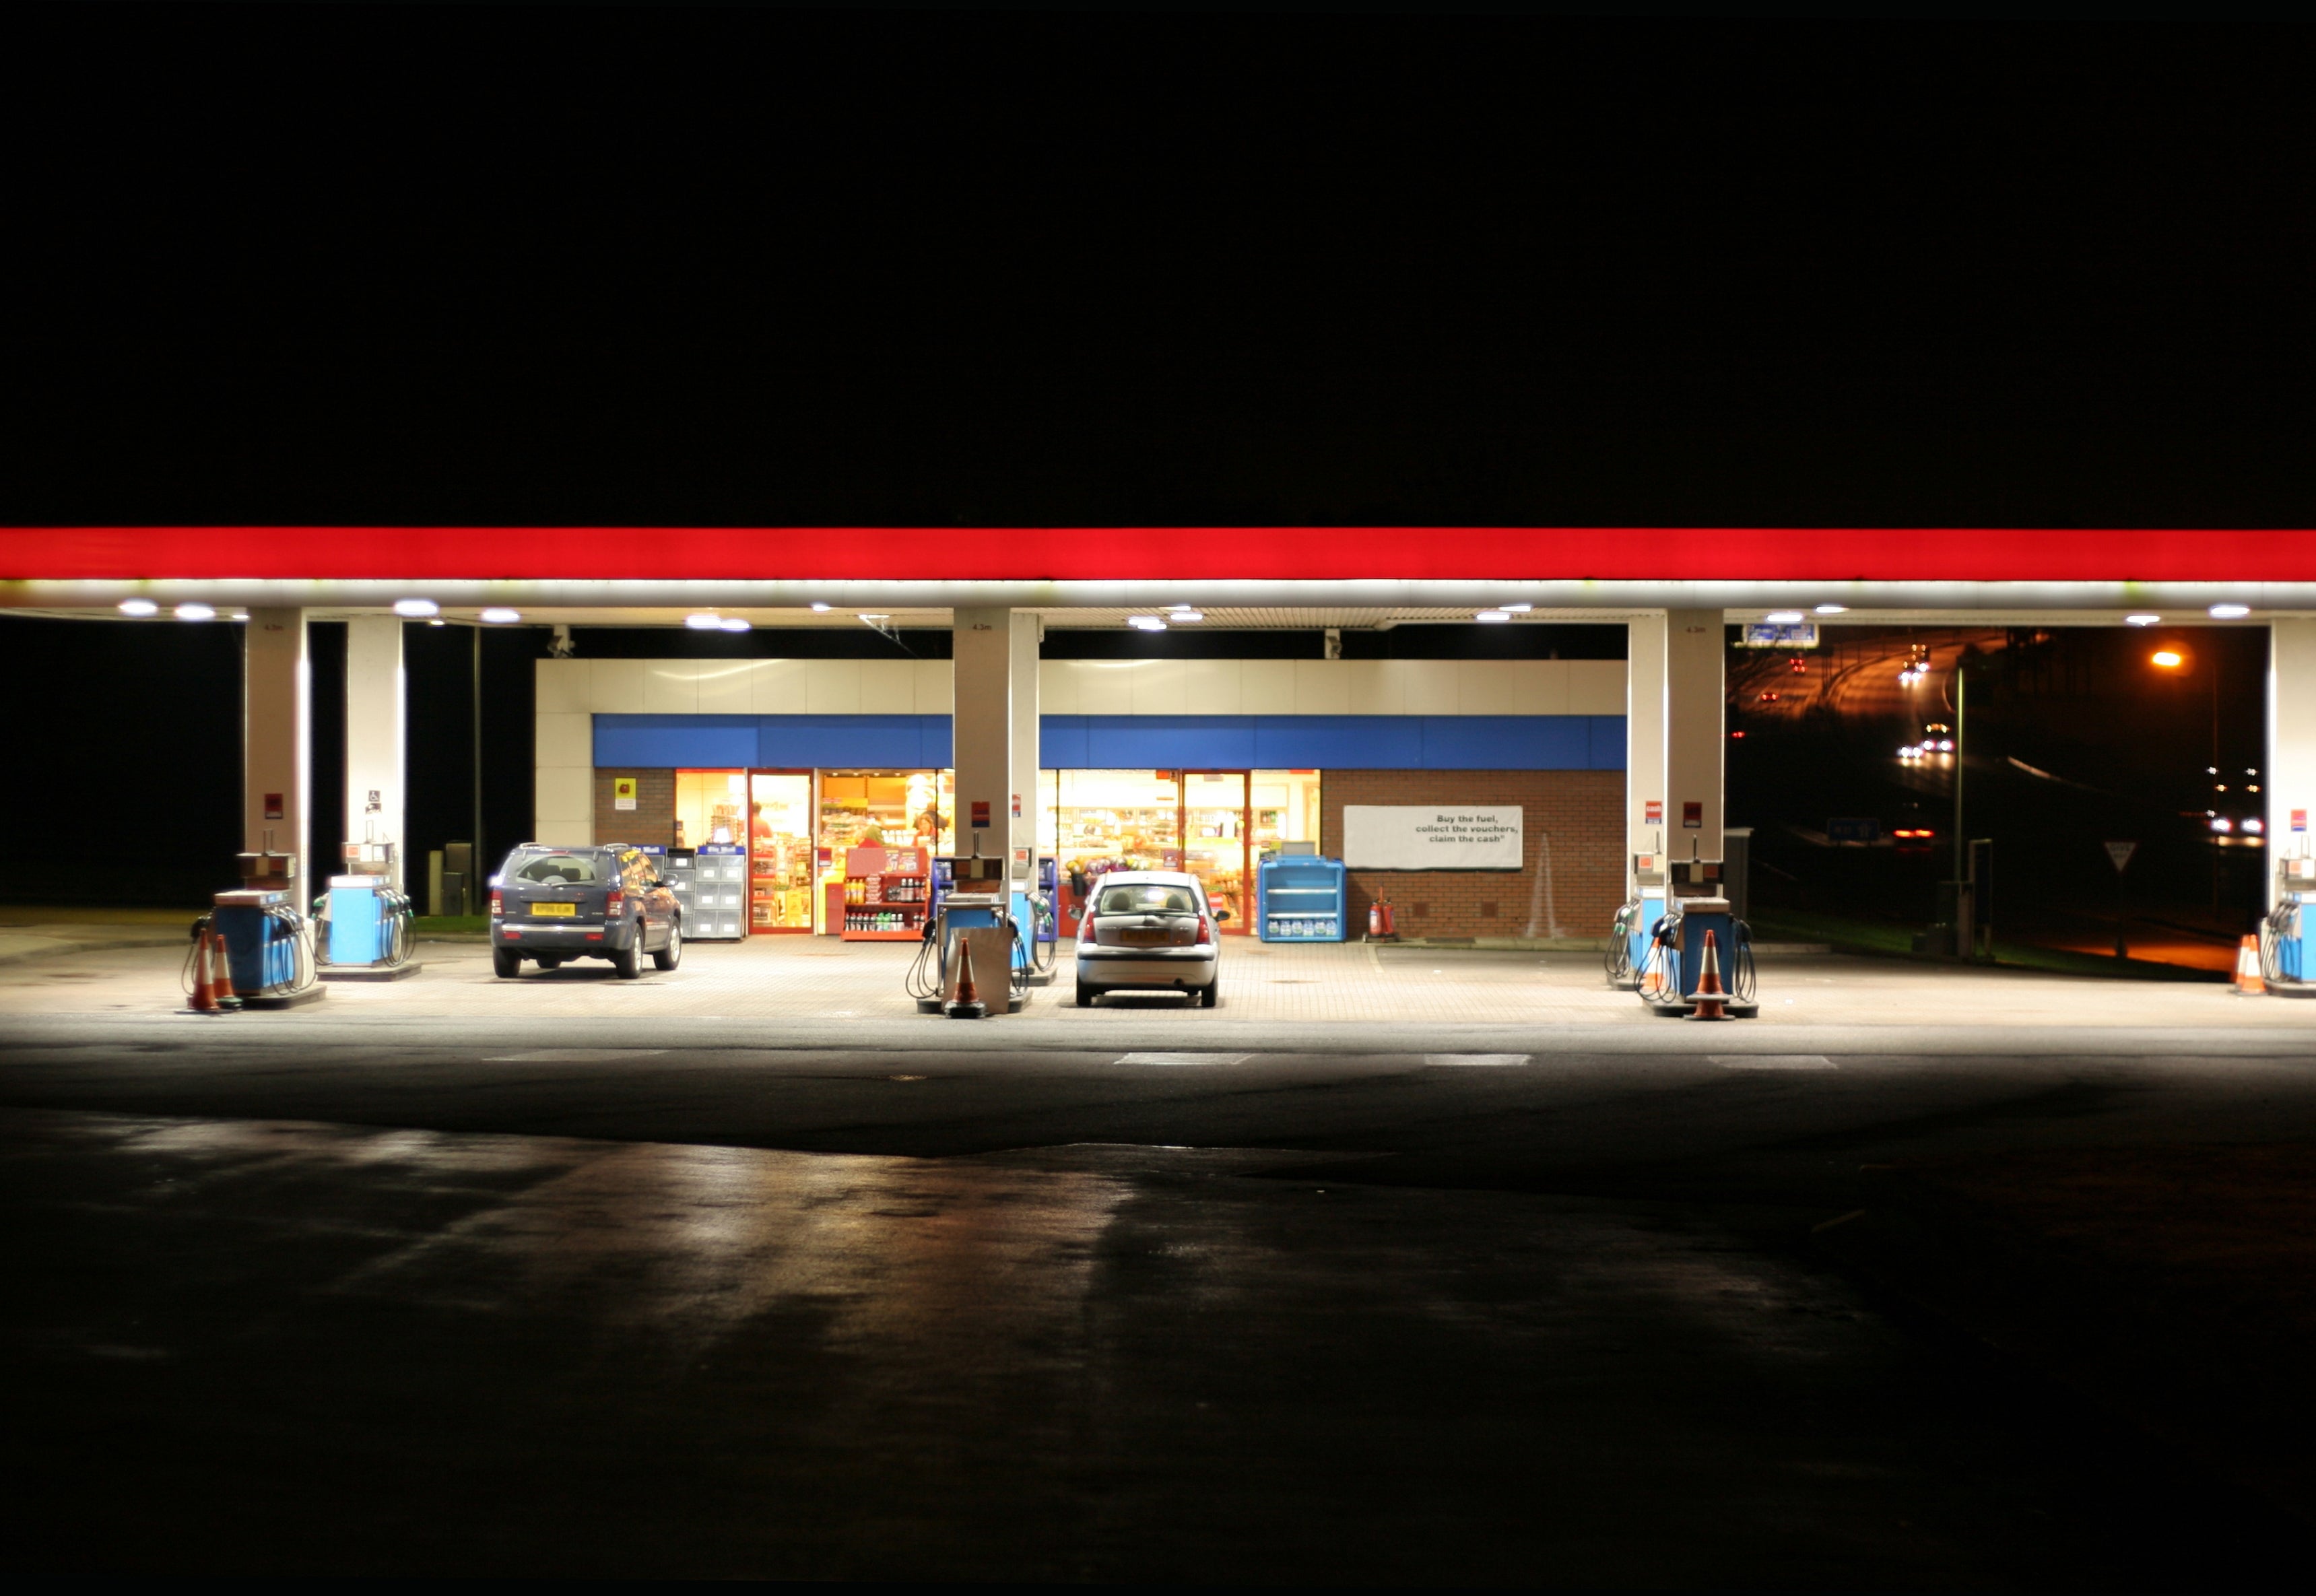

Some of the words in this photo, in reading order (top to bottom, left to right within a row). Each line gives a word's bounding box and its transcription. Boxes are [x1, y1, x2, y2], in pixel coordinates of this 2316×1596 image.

[1436, 814, 1455, 824] Buy
[1476, 814, 1498, 824] fuel,
[1470, 825, 1518, 834] vouchers,
[1429, 834, 1456, 842] claim
